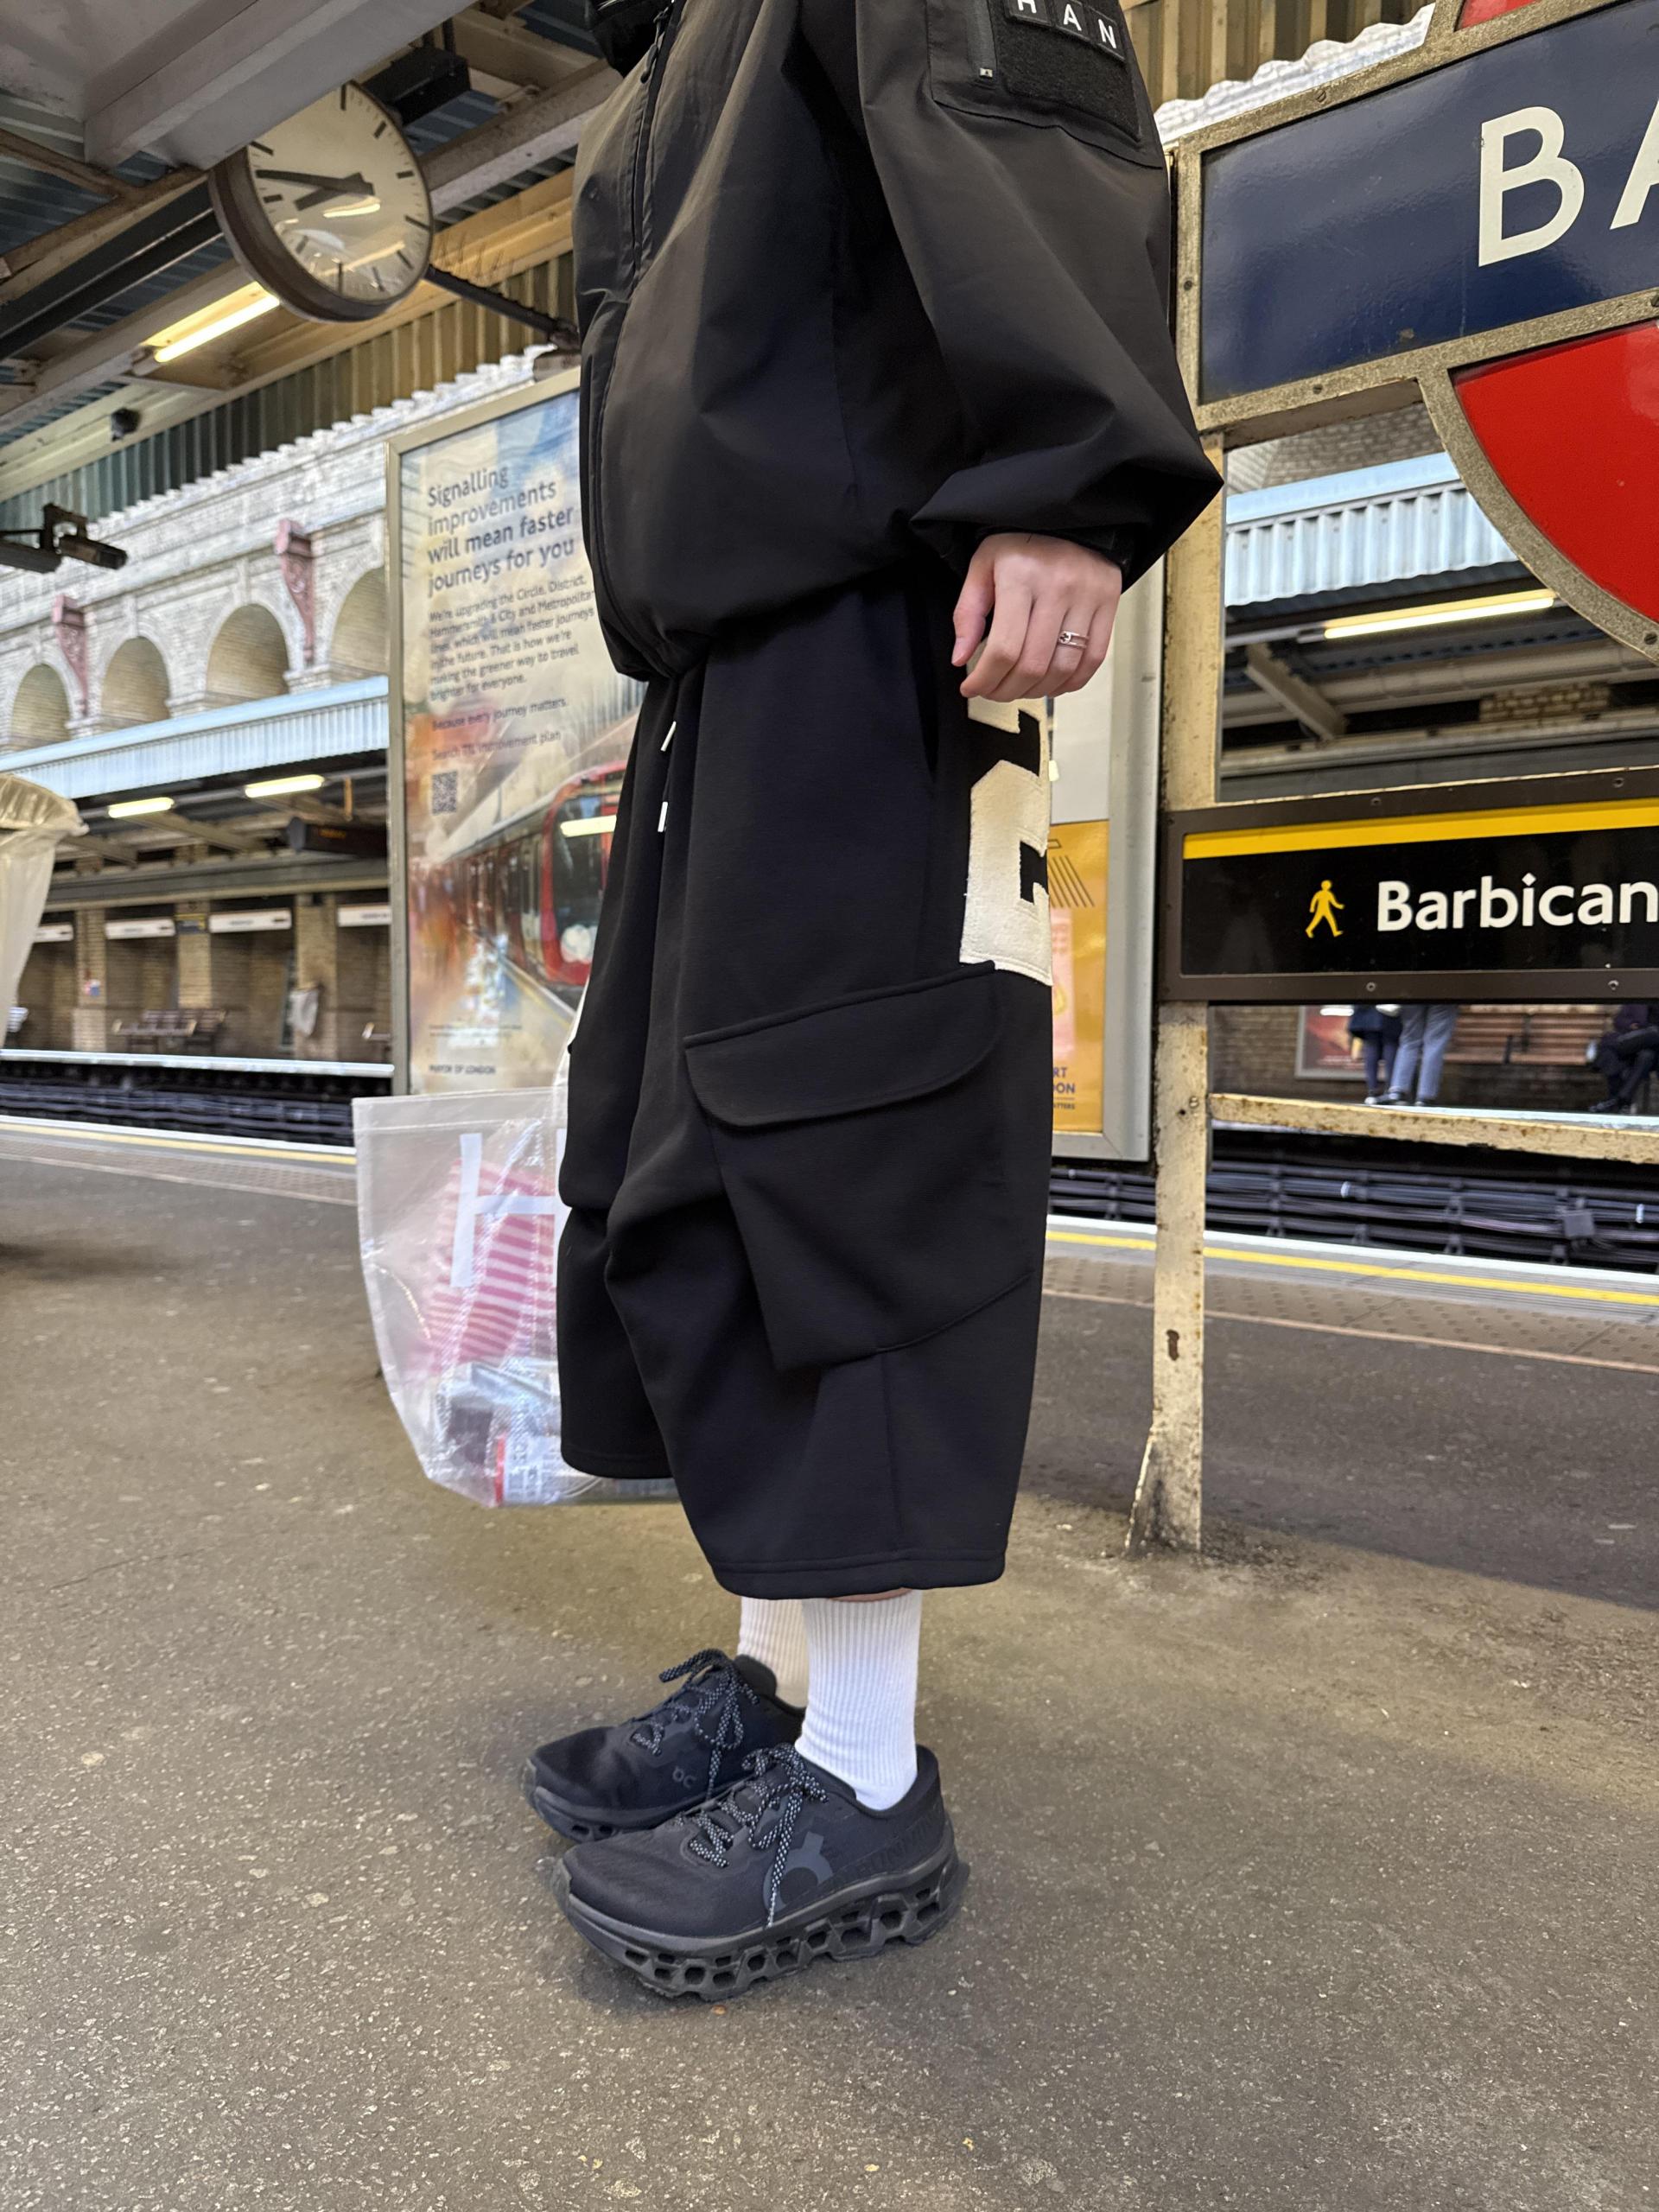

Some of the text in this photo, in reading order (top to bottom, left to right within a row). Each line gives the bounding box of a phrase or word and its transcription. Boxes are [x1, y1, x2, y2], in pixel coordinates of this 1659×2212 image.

[428, 467, 508, 508] Signalling
[429, 481, 556, 536] improvements
[428, 507, 574, 563] will mean faster
[429, 538, 574, 597] journeys for you
[519, 605, 537, 616] and
[556, 607, 594, 628] journeys
[516, 654, 536, 668] way
[537, 652, 549, 662] to
[524, 638, 543, 648] how
[1377, 873, 1658, 931] Barbican
